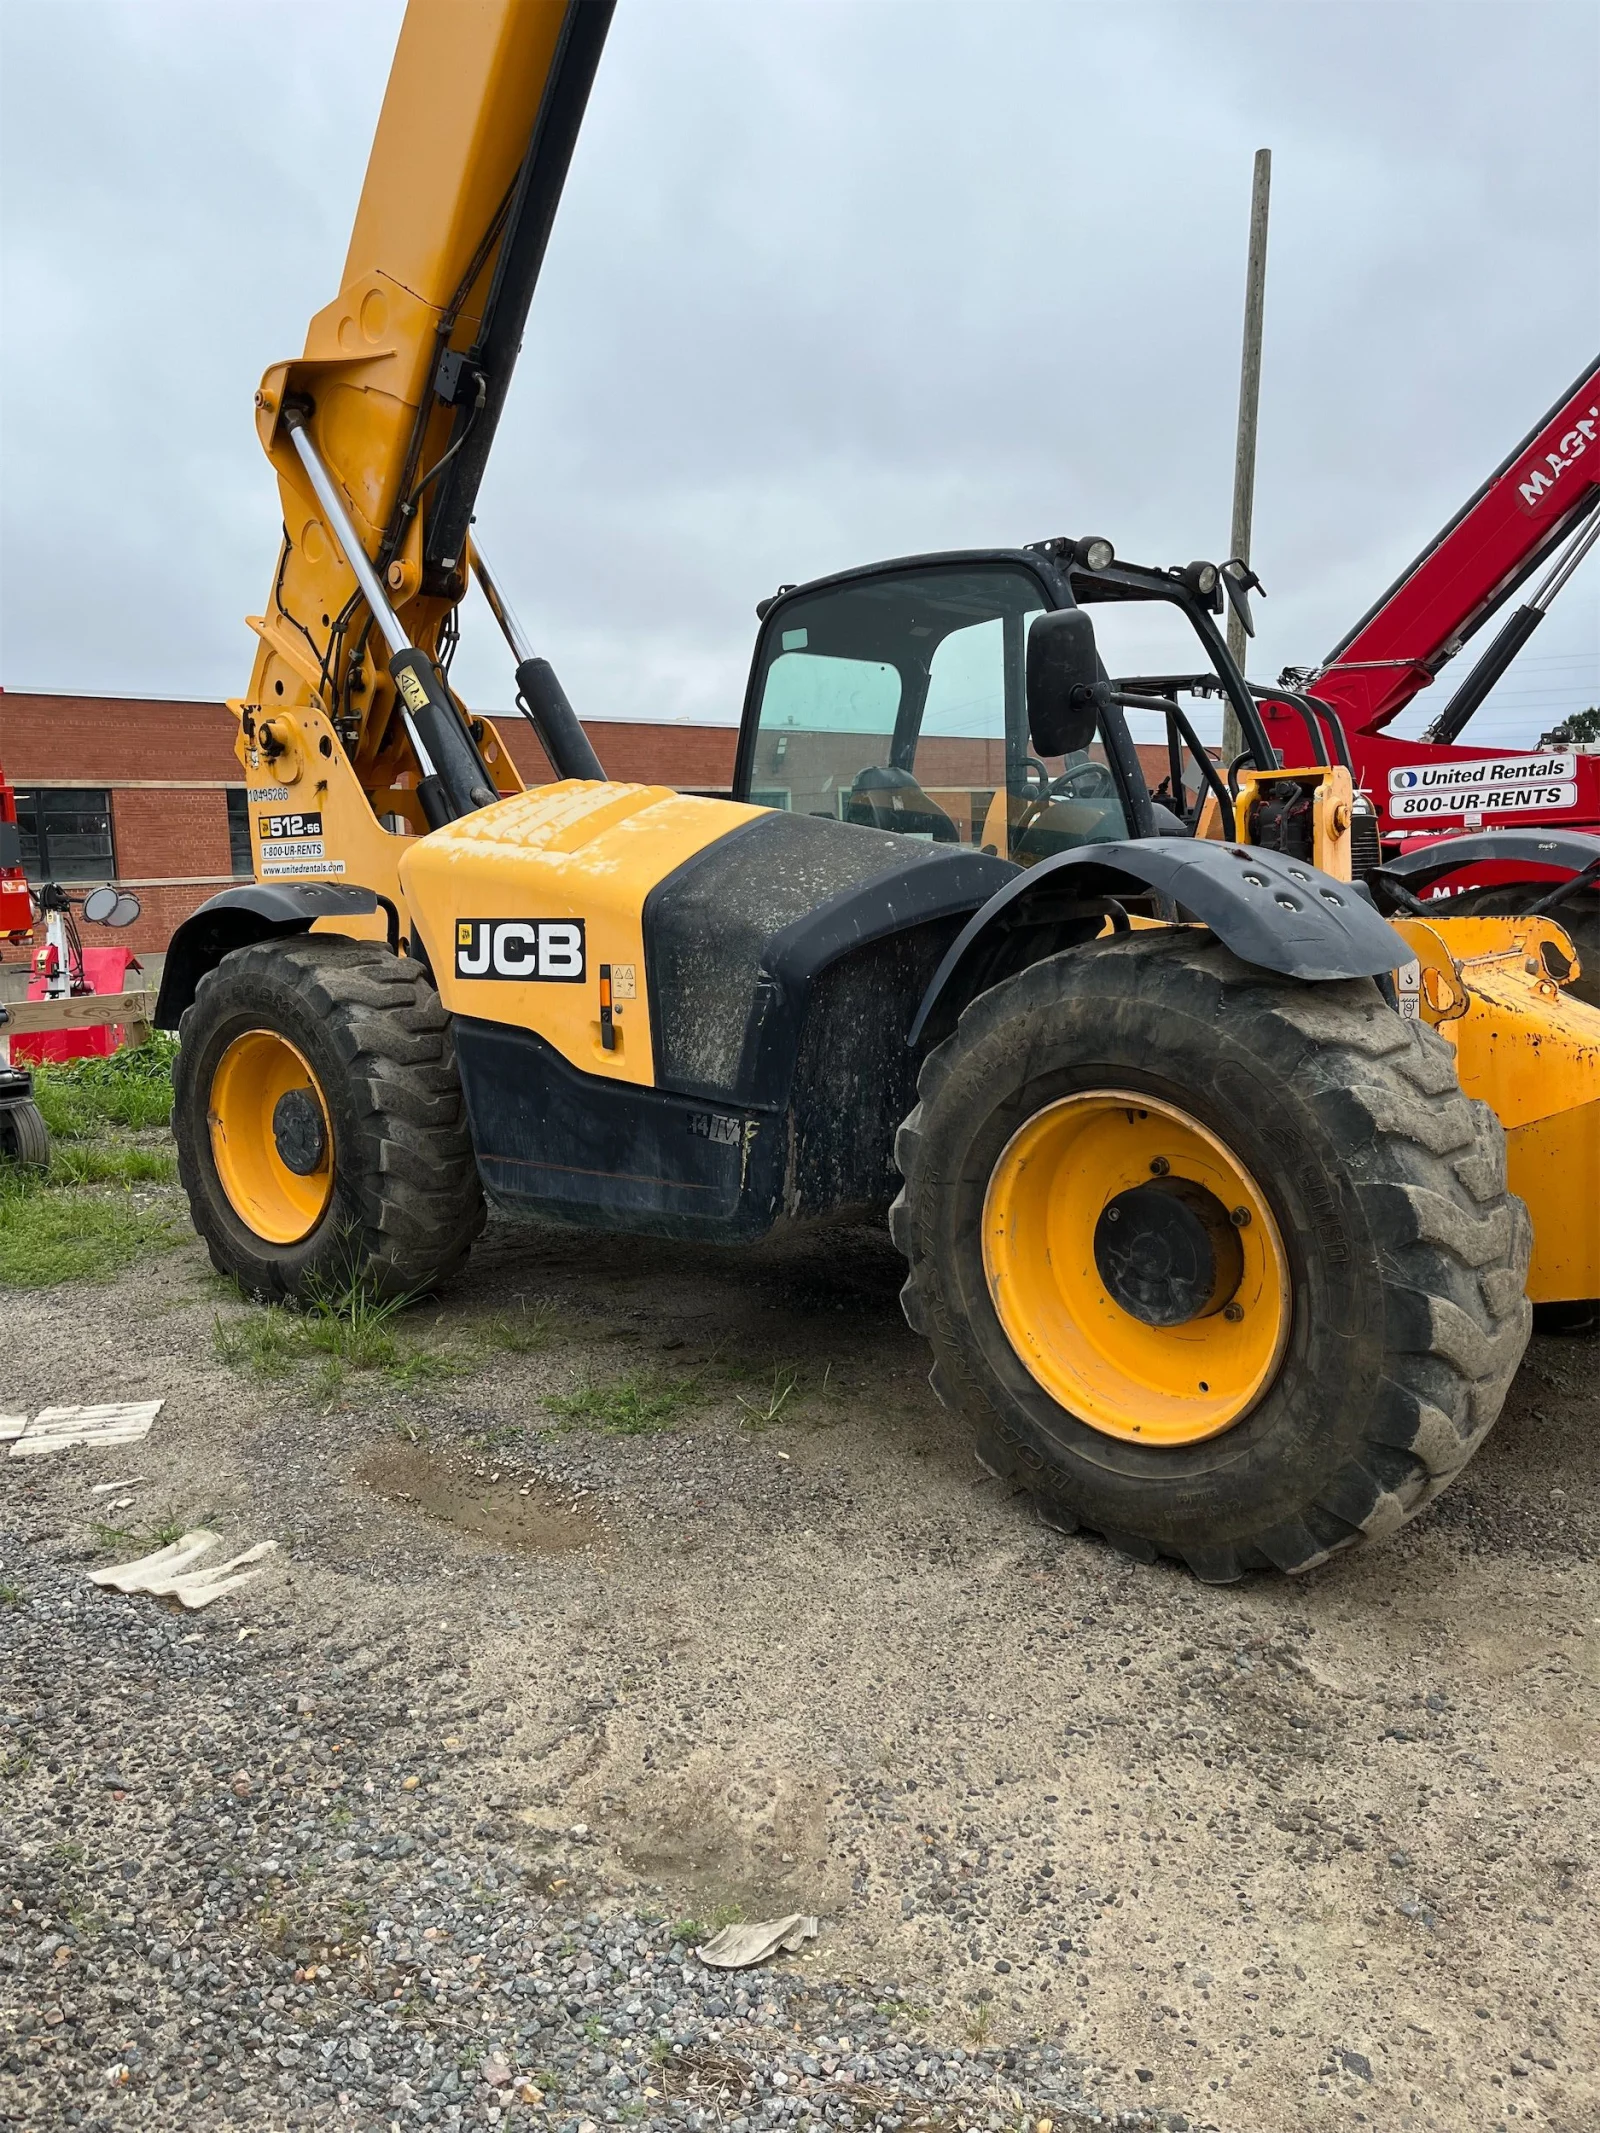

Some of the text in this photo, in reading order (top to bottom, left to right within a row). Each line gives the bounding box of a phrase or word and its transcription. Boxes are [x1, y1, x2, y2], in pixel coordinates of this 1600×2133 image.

[1422, 759, 1565, 786] United Rentals
[248, 787, 289, 802] 10495266
[1403, 787, 1562, 814] 800-UR-RENTS
[263, 844, 322, 857] 1-800-UR-RENTS
[263, 862, 344, 875] www.unitedrentals.com
[458, 923, 583, 977] JCB
[1297, 1164, 1351, 1264] CAMSO
